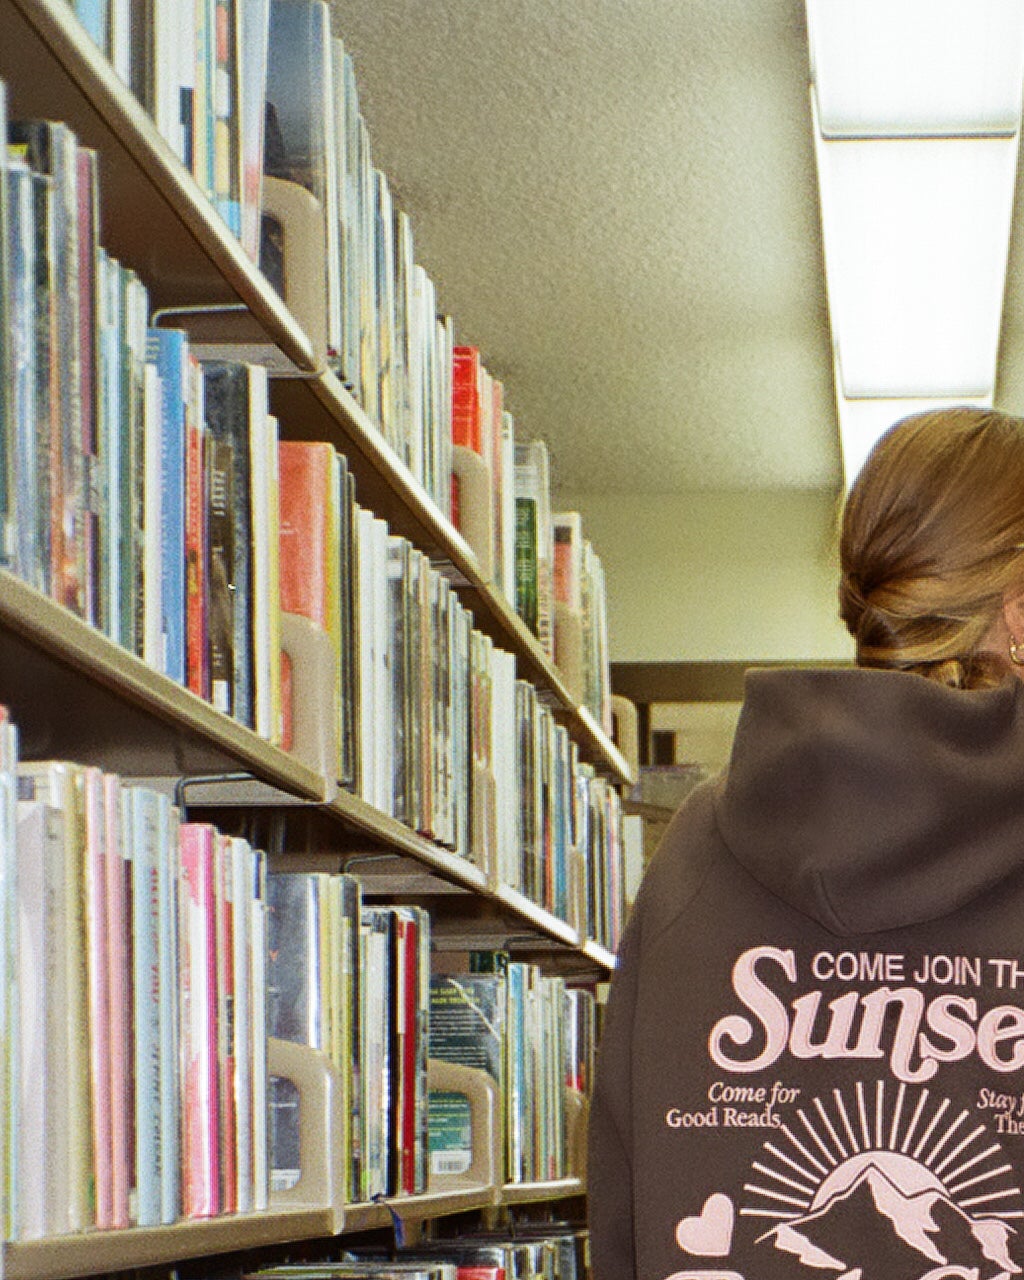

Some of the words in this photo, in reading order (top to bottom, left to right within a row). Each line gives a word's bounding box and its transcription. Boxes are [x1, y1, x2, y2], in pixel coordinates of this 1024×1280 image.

[812, 951, 905, 981] COME
[914, 955, 981, 986] JOIN
[708, 1081, 765, 1103] Come
[766, 1081, 801, 1110] for
[976, 1087, 1015, 1115] Stay
[666, 1106, 719, 1128] Good
